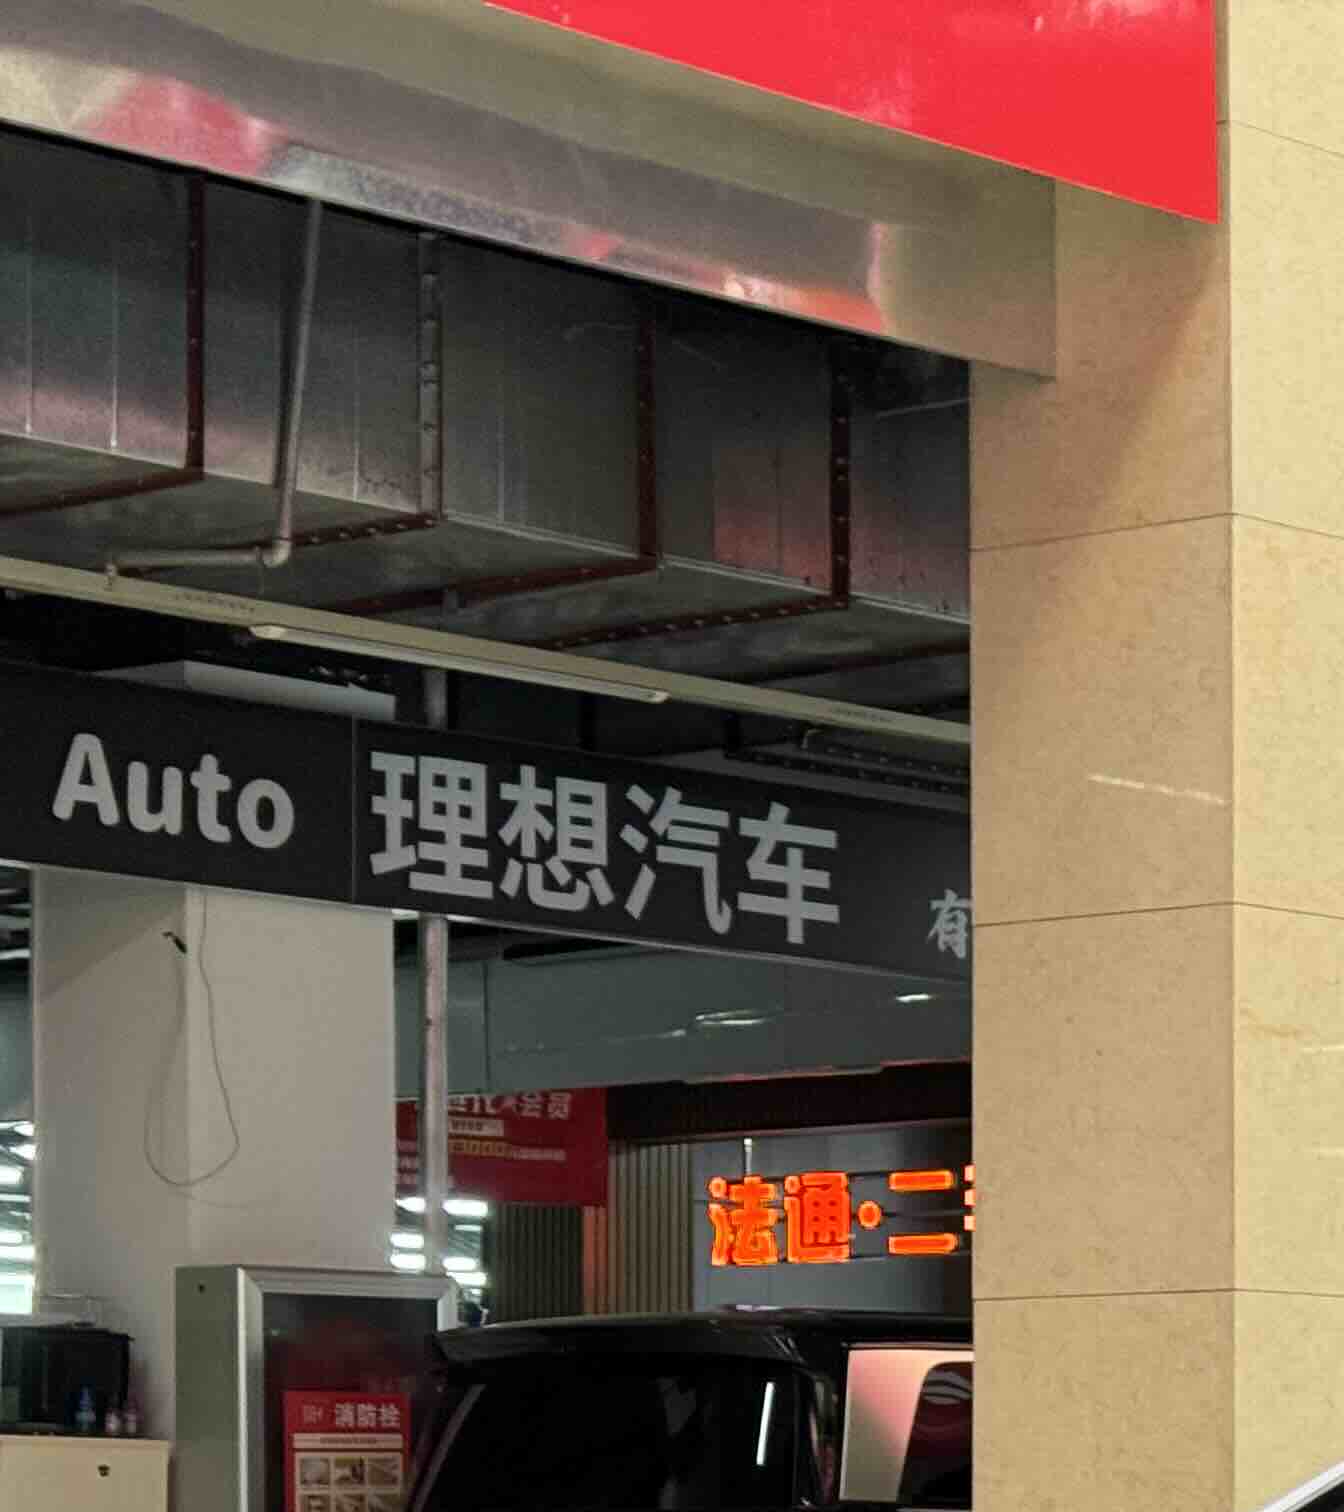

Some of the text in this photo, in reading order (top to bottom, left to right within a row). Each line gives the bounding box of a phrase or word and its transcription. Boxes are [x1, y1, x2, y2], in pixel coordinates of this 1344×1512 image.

[52, 731, 296, 851] Auto
[368, 750, 842, 945] 理想汽车
[708, 1164, 976, 1266] 法通·二
